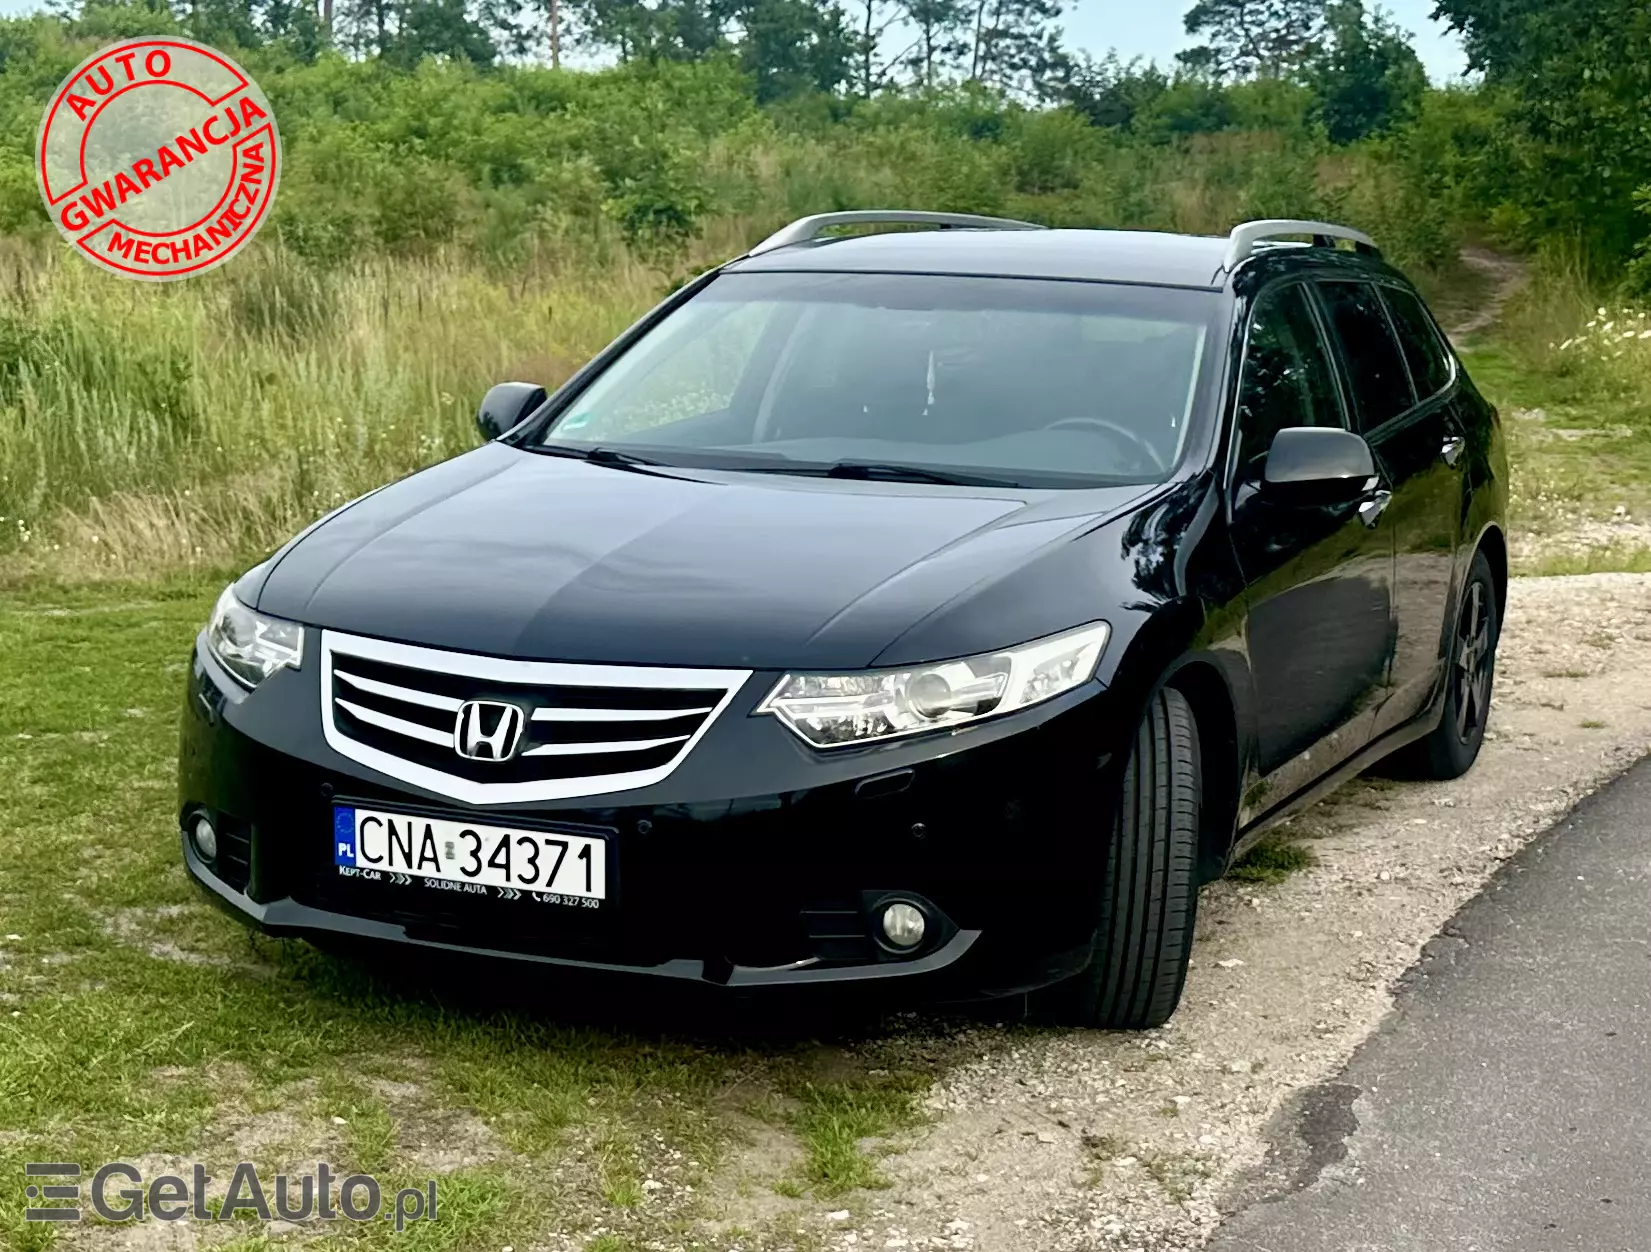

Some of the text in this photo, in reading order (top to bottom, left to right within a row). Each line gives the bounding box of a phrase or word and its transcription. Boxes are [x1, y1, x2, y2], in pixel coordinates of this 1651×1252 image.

[338, 842, 354, 858] PL
[359, 816, 592, 893] CNA 34371
[424, 878, 462, 892] SOLIDNE
[463, 882, 488, 895] AUTA
[562, 895, 580, 906] 327
[581, 897, 600, 909] 500
